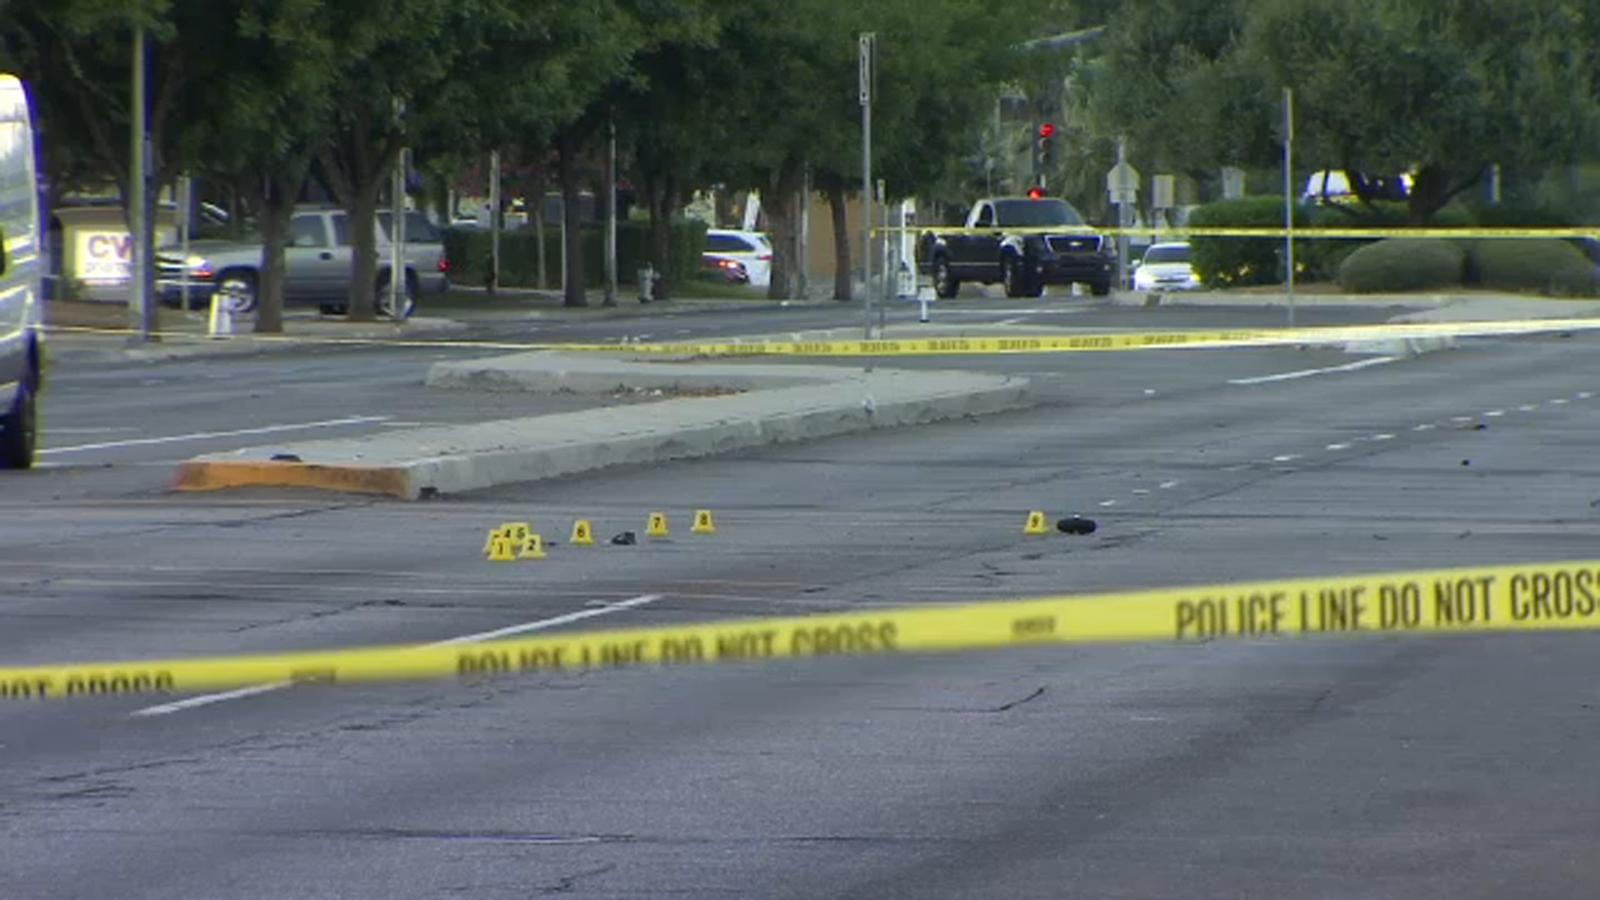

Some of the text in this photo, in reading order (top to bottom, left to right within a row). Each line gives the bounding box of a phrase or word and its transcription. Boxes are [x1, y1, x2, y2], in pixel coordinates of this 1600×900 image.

[88, 235, 133, 259] CV
[1175, 591, 1286, 640] POLICE
[1299, 585, 1367, 632] LINE
[1379, 581, 1420, 629] DO
[1434, 575, 1496, 626] NOT
